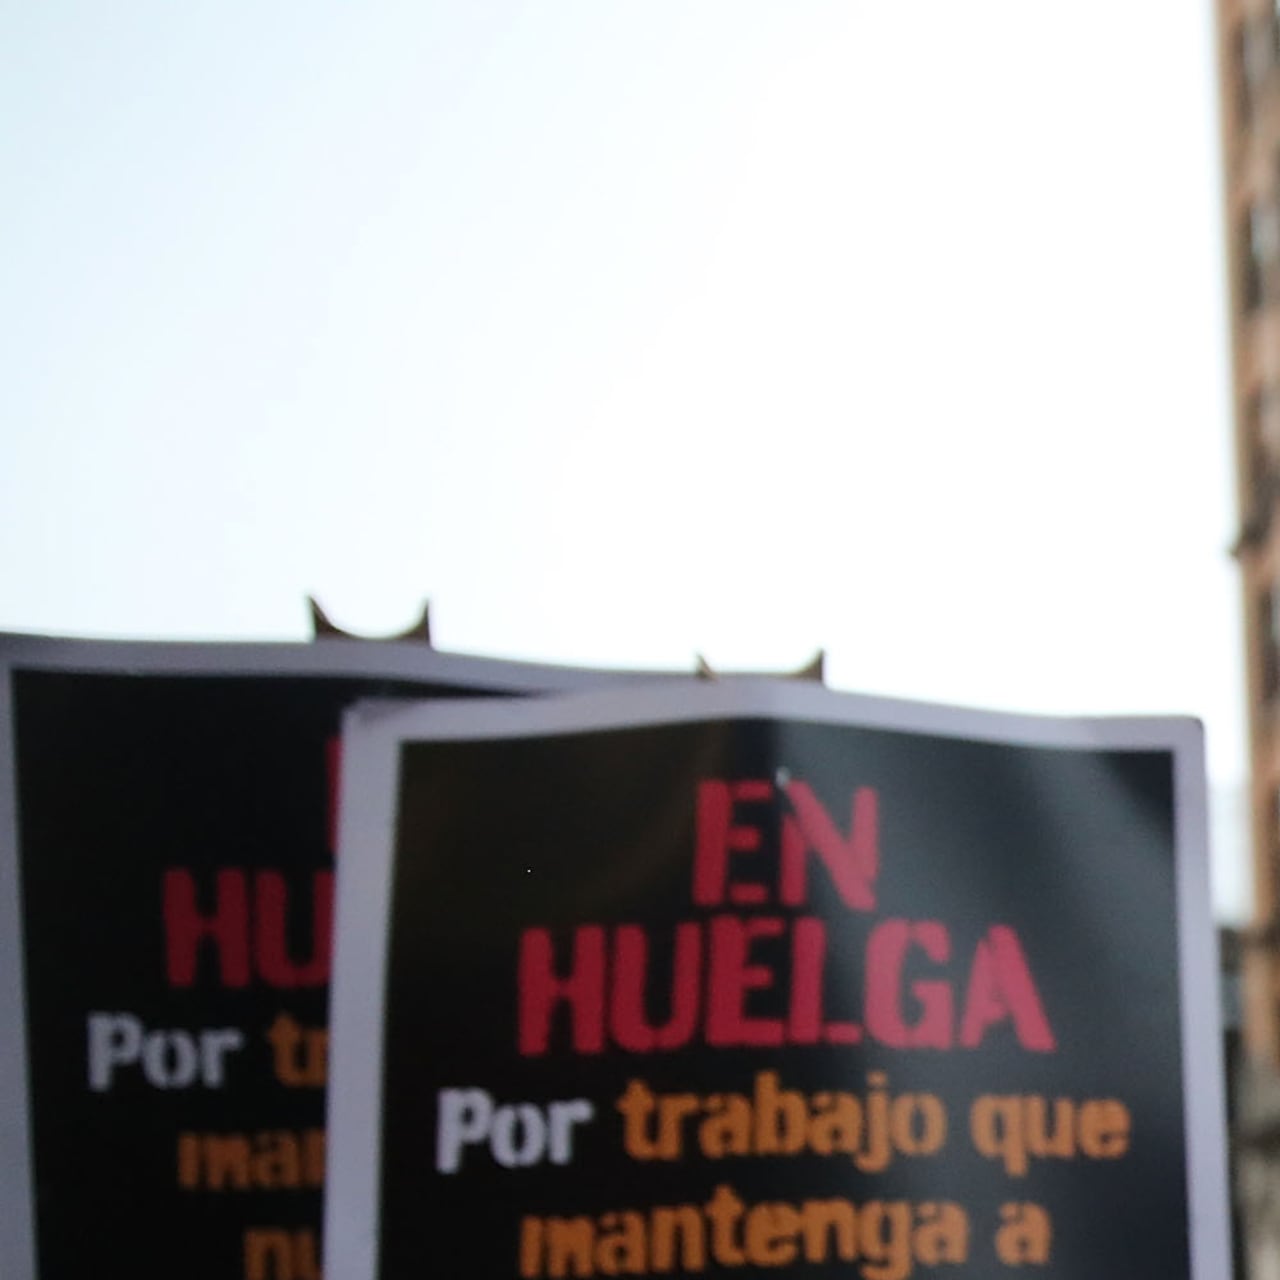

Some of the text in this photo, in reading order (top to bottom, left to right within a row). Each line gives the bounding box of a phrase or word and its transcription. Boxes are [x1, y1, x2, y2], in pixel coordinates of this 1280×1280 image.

[693, 778, 881, 913] EN
[516, 915, 1058, 1057] HUELGA
[86, 1010, 243, 1093] Por
[435, 1086, 594, 1175] Por
[616, 1070, 948, 1173] trabajo
[969, 1092, 1132, 1178] que
[994, 1199, 1053, 1266] a
